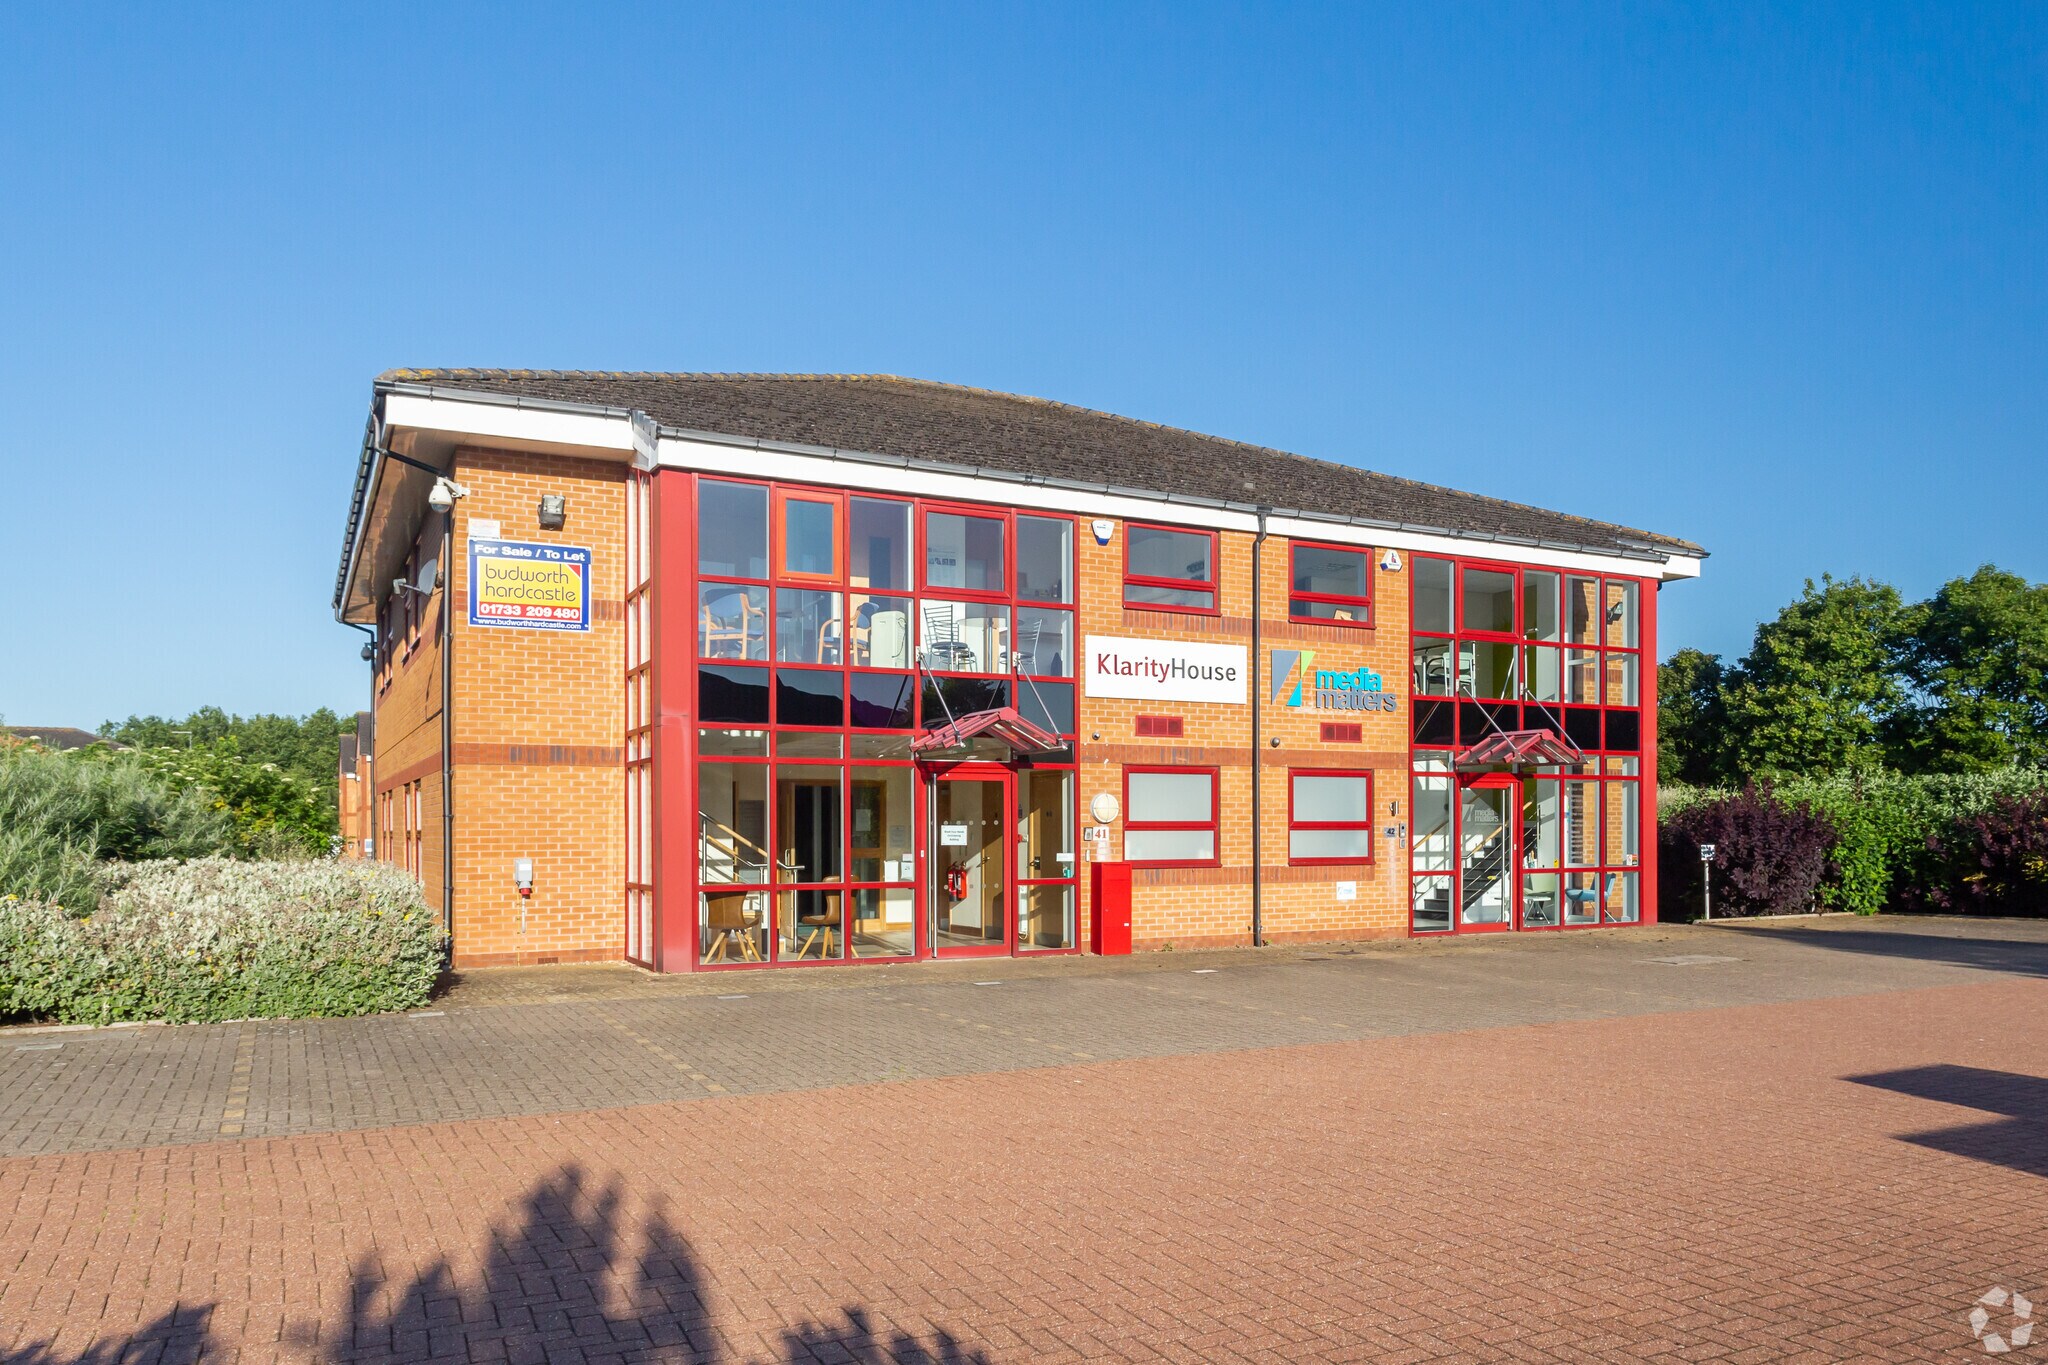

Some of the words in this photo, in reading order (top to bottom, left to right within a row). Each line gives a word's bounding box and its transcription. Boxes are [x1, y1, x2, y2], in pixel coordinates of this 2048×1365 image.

[474, 544, 498, 554] For
[501, 547, 532, 557] Sale
[544, 549, 560, 559] To
[563, 551, 585, 561] Let
[485, 563, 569, 584] budworth
[485, 581, 576, 602] hardcastle
[480, 603, 521, 616] 01733
[526, 606, 552, 617] 209
[553, 608, 579, 619] 480
[477, 618, 581, 630] www.budworthhardcastle.com
[1315, 667, 1382, 692] media
[1315, 688, 1397, 712] matters
[1095, 829, 1106, 838] 41
